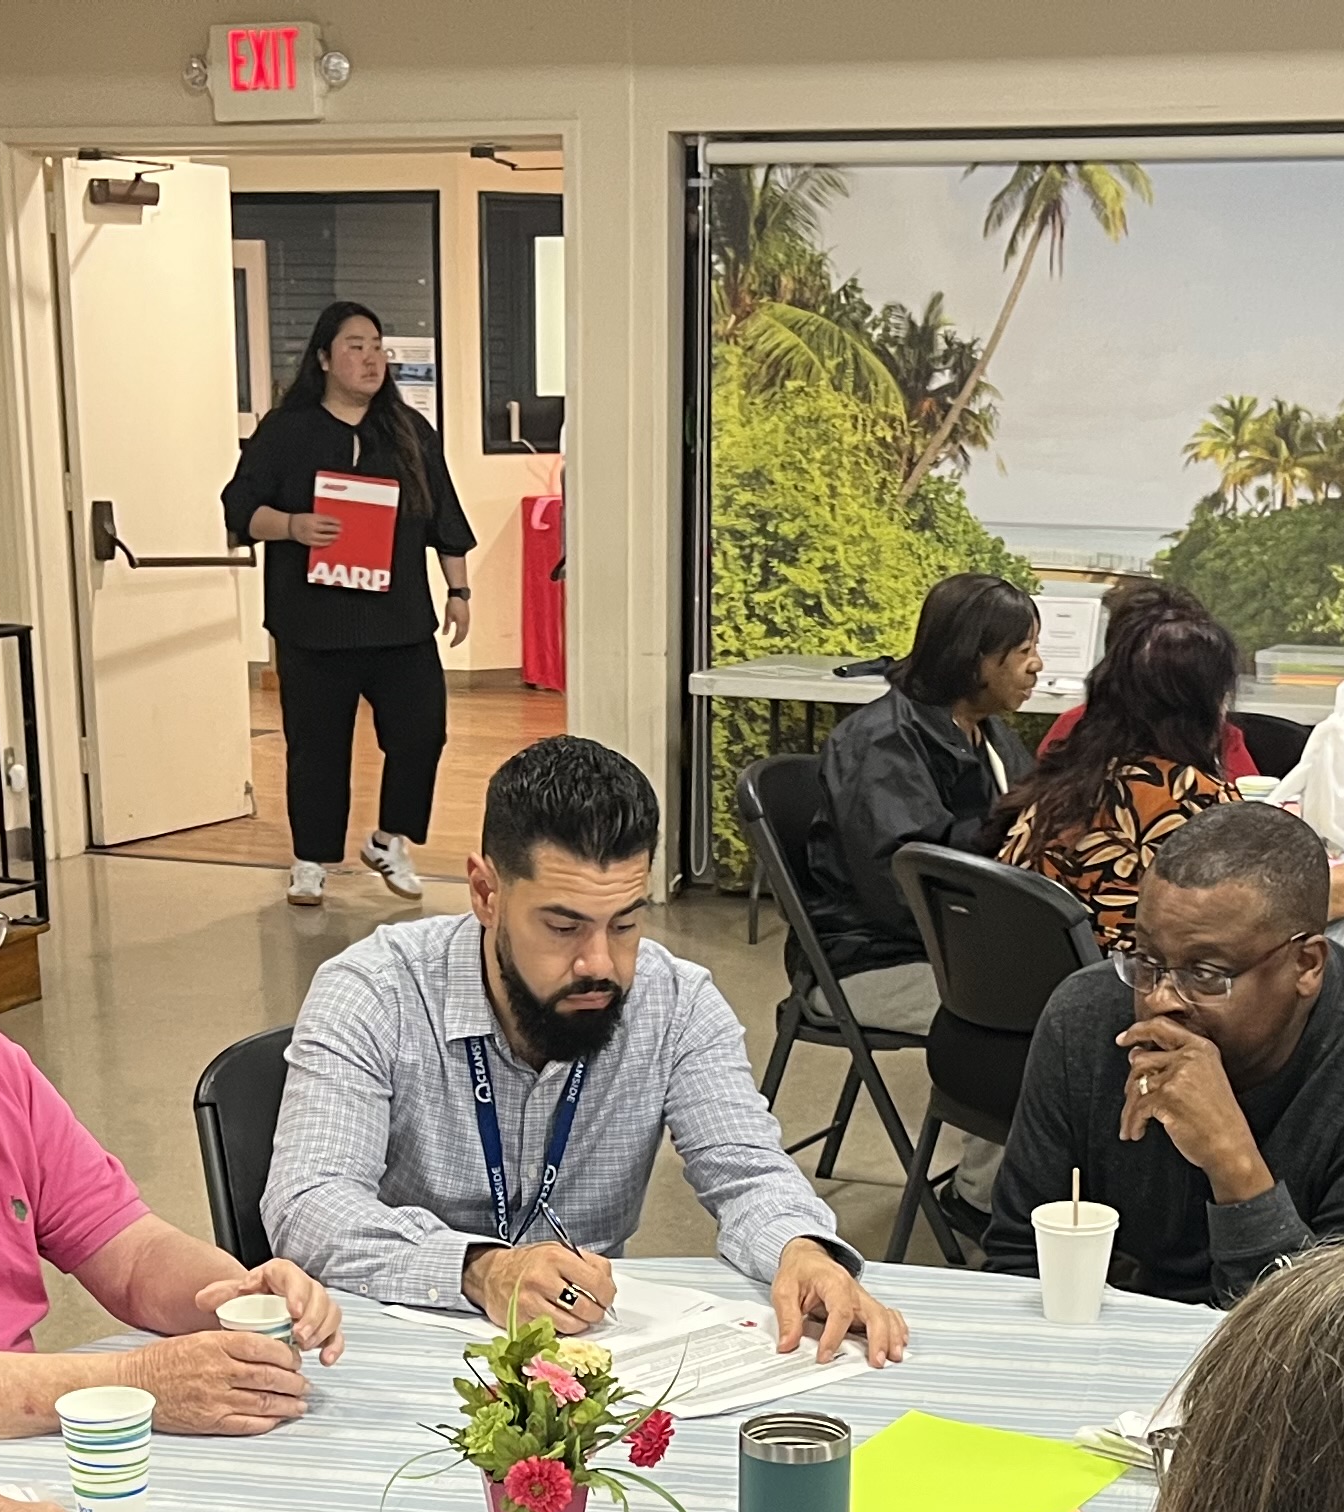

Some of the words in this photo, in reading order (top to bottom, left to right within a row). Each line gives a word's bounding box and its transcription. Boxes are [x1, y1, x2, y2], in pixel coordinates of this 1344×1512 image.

[228, 27, 299, 92] EXIT
[307, 561, 390, 592] AARP
[470, 1038, 493, 1104] OCEANSI
[566, 1060, 585, 1104] ANSIDE
[491, 1166, 509, 1240] OCEANSIDE
